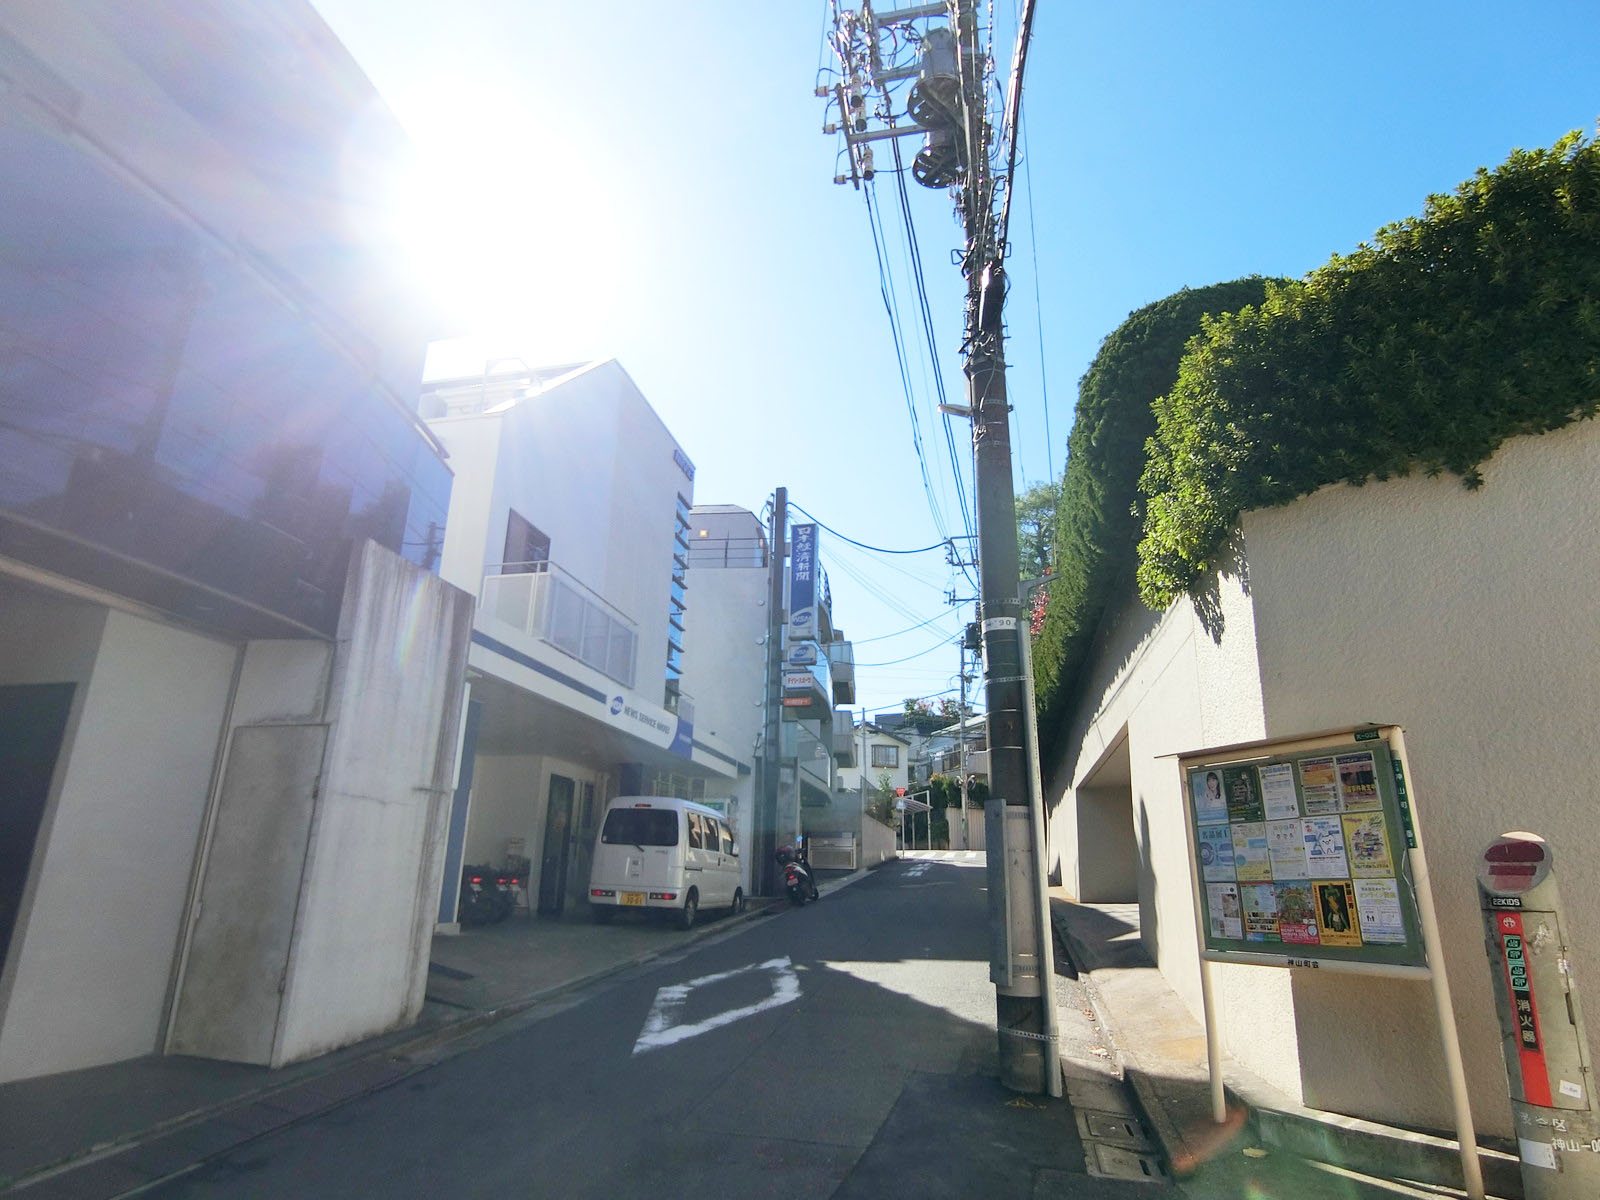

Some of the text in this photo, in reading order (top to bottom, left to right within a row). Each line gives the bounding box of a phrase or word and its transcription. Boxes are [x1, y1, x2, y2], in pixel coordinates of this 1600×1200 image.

[624, 705, 638, 720] NEWS
[1517, 999, 1536, 1043] 消火器
